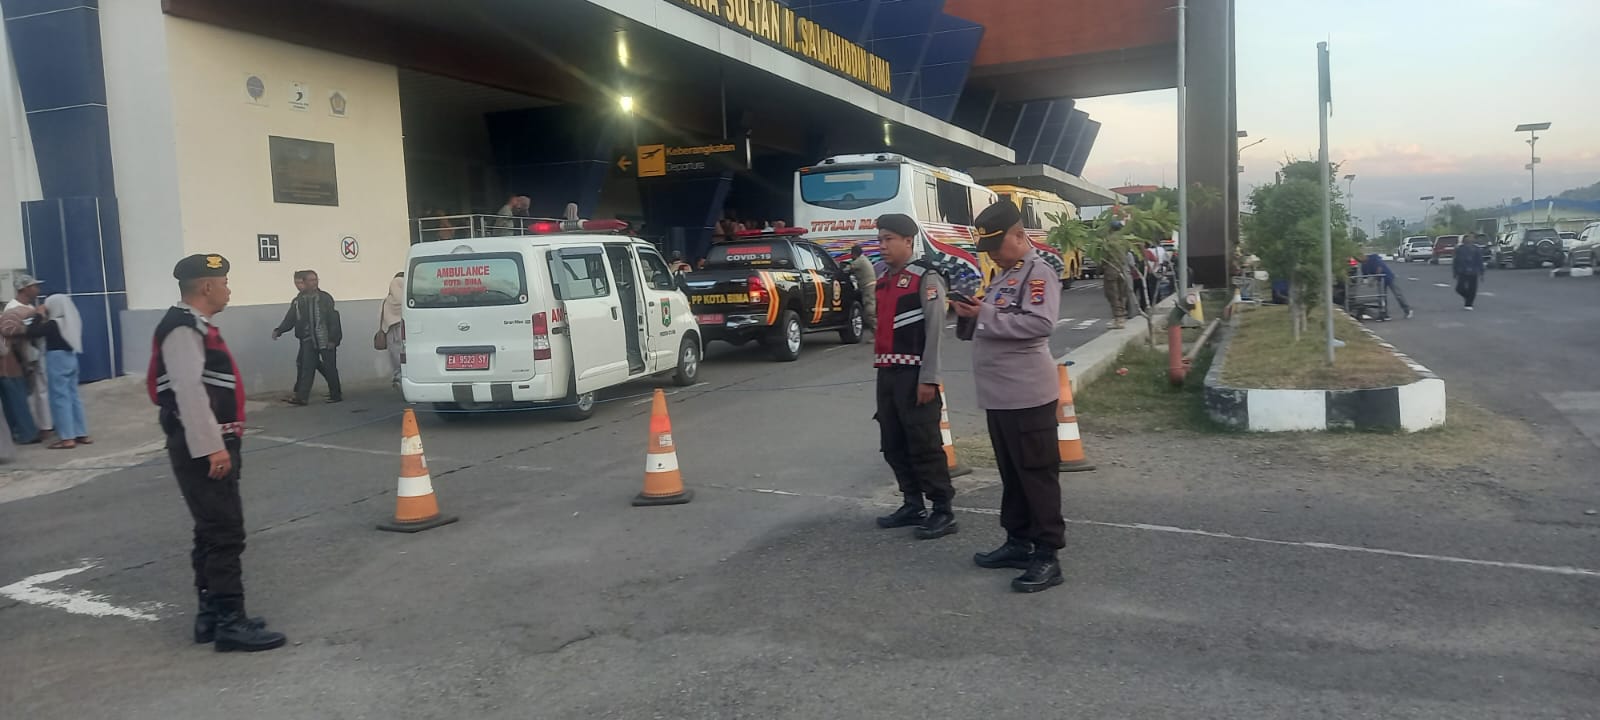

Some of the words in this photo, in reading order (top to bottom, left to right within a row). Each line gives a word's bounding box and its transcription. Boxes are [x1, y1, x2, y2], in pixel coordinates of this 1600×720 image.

[800, 17, 868, 82] SALAHUDDIN
[870, 53, 892, 93] BIMA
[810, 219, 857, 232] TITIAN
[726, 253, 772, 261] COVID-19
[436, 265, 490, 278] AMBULANCE
[691, 295, 703, 305] PP
[703, 294, 727, 304] KOTA
[727, 293, 750, 303] BIMA
[460, 355, 475, 364] 9523
